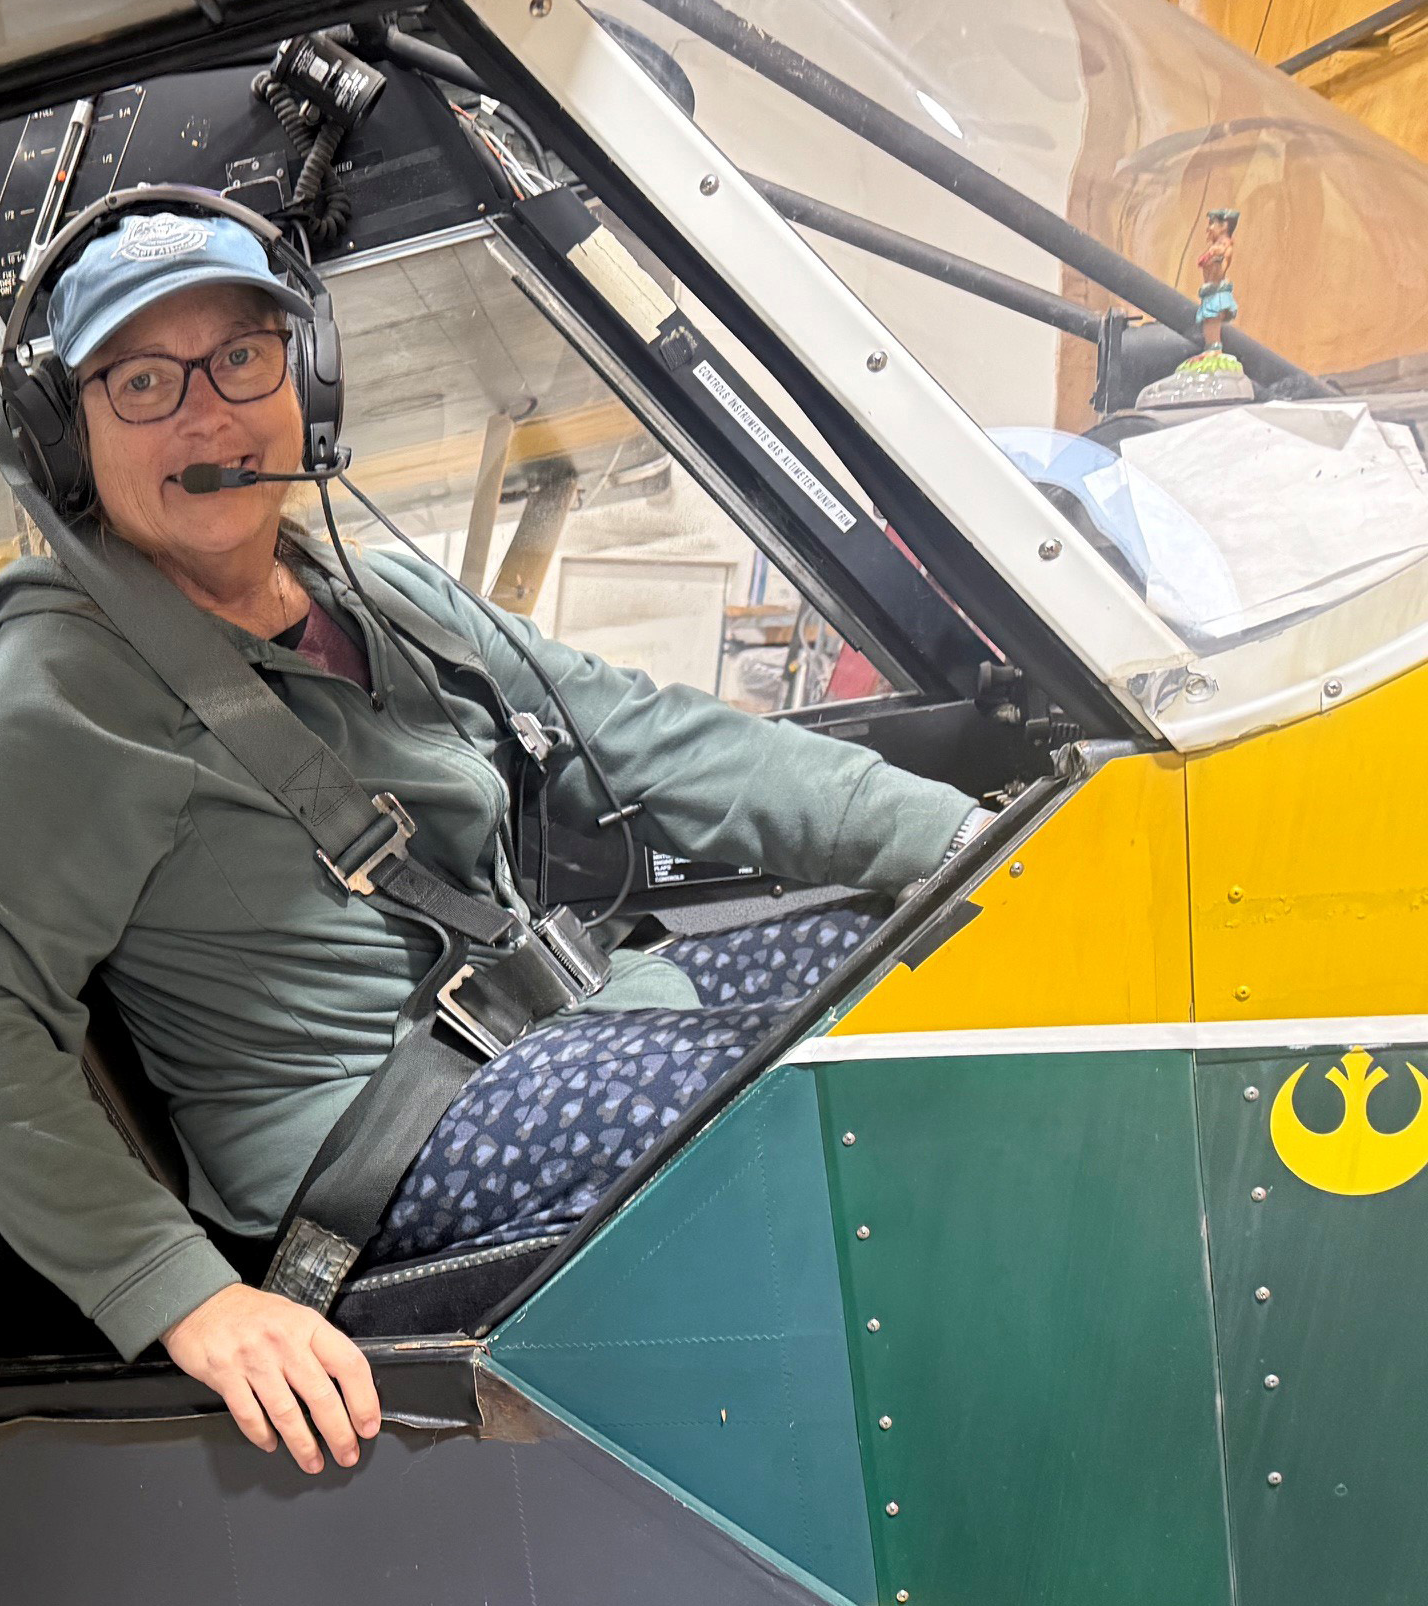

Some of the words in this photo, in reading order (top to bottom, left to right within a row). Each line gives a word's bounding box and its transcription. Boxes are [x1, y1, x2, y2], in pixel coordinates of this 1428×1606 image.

[2, 269, 17, 279] FUEL
[698, 365, 732, 401] CONTROLS
[727, 396, 771, 443] INSTRUMENTS
[766, 441, 784, 458] GAS
[780, 455, 817, 492] ALTIMETER
[813, 488, 837, 511] RUNUP
[835, 510, 854, 528] TRIM
[654, 864, 672, 873] FLAPS
[655, 873, 685, 883] CONTROLS
